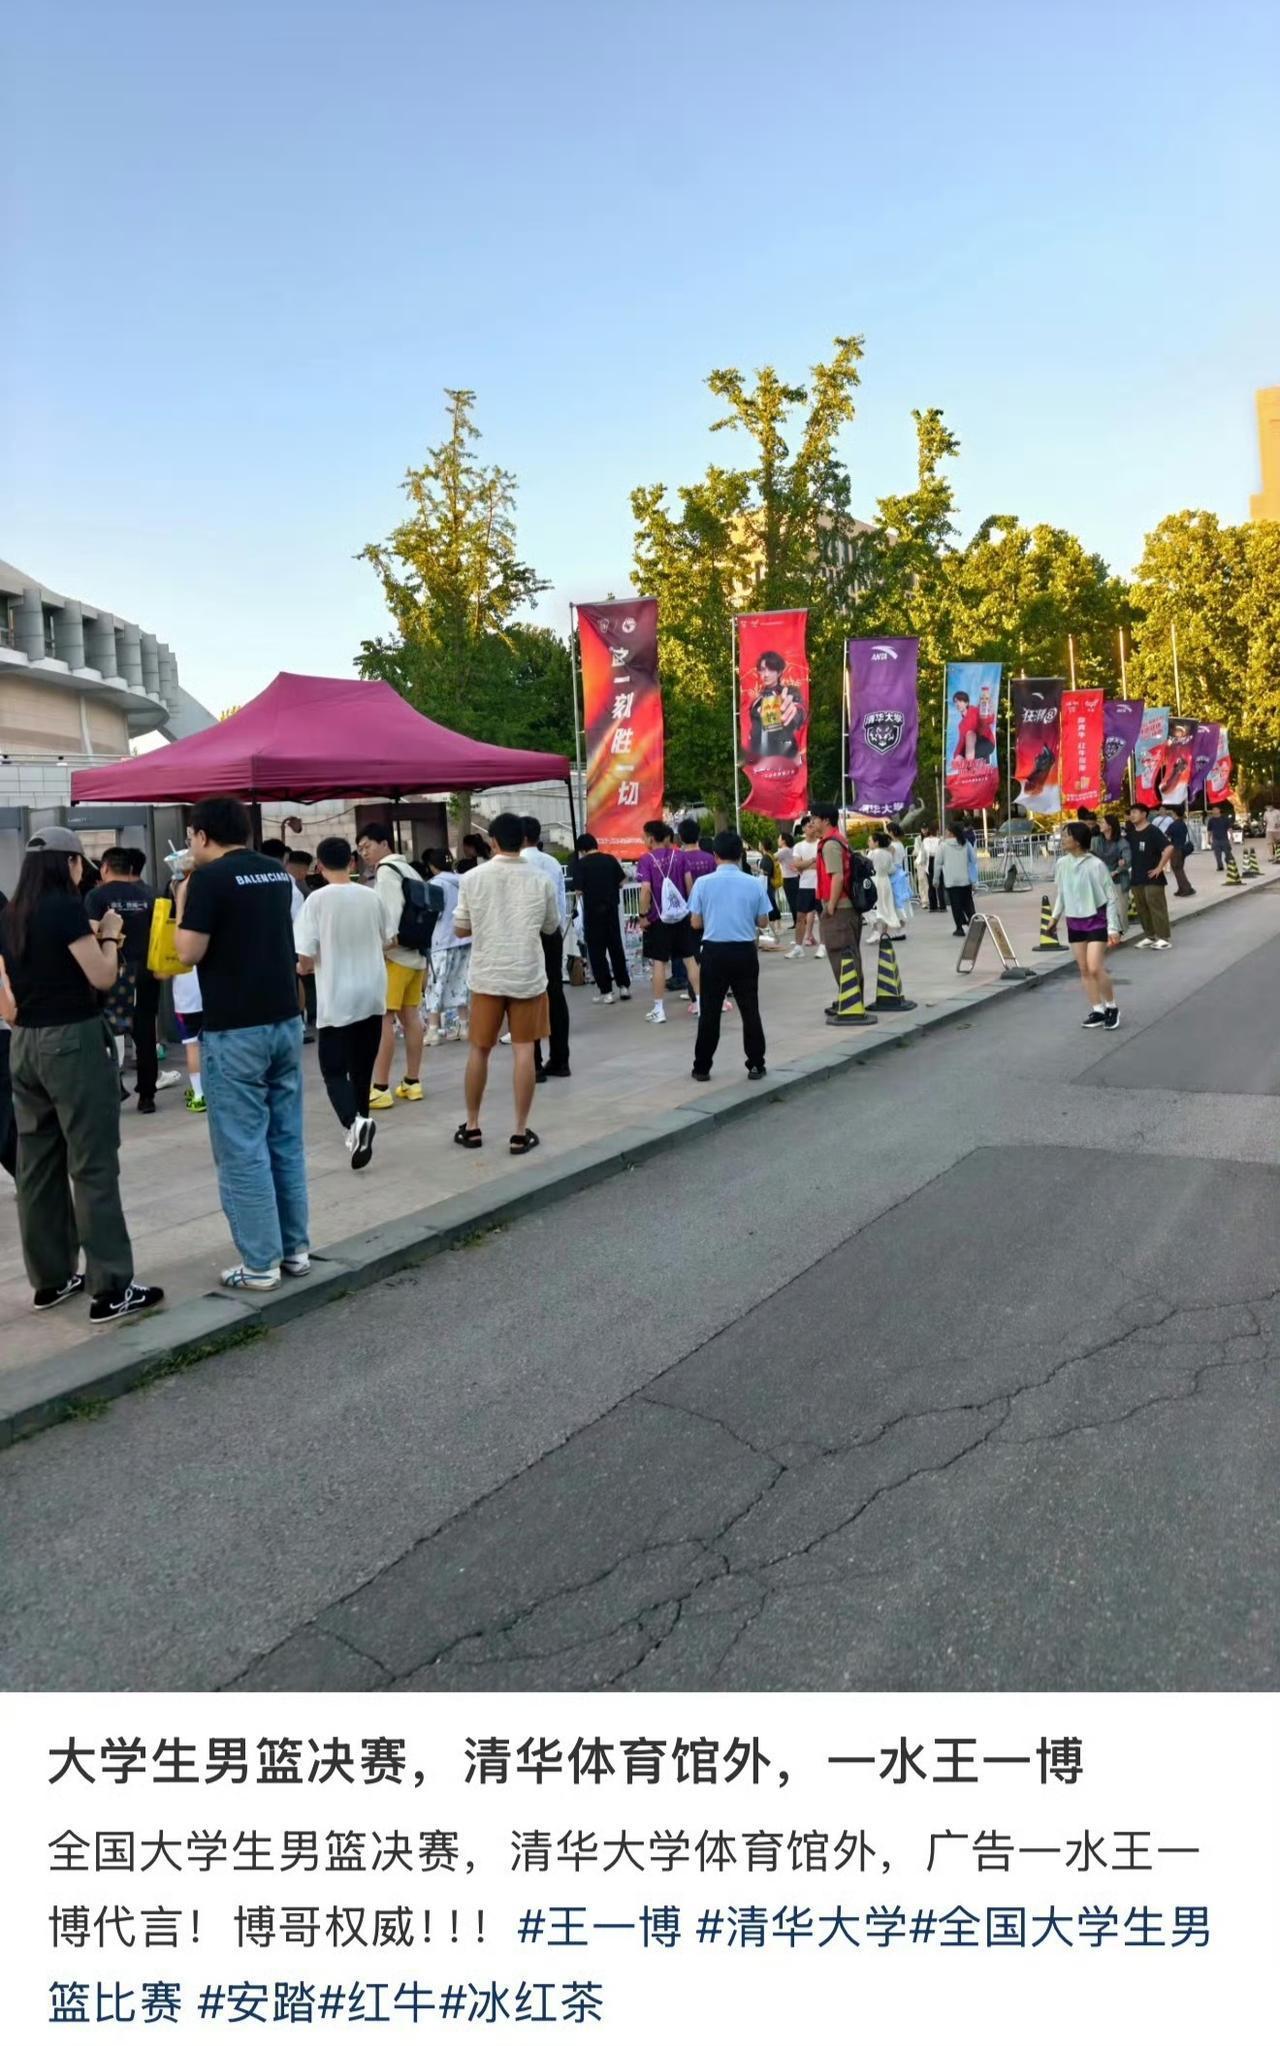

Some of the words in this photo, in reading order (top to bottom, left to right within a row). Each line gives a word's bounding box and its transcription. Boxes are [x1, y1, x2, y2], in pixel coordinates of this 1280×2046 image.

[609, 646, 639, 806] 这一刻胜一切
